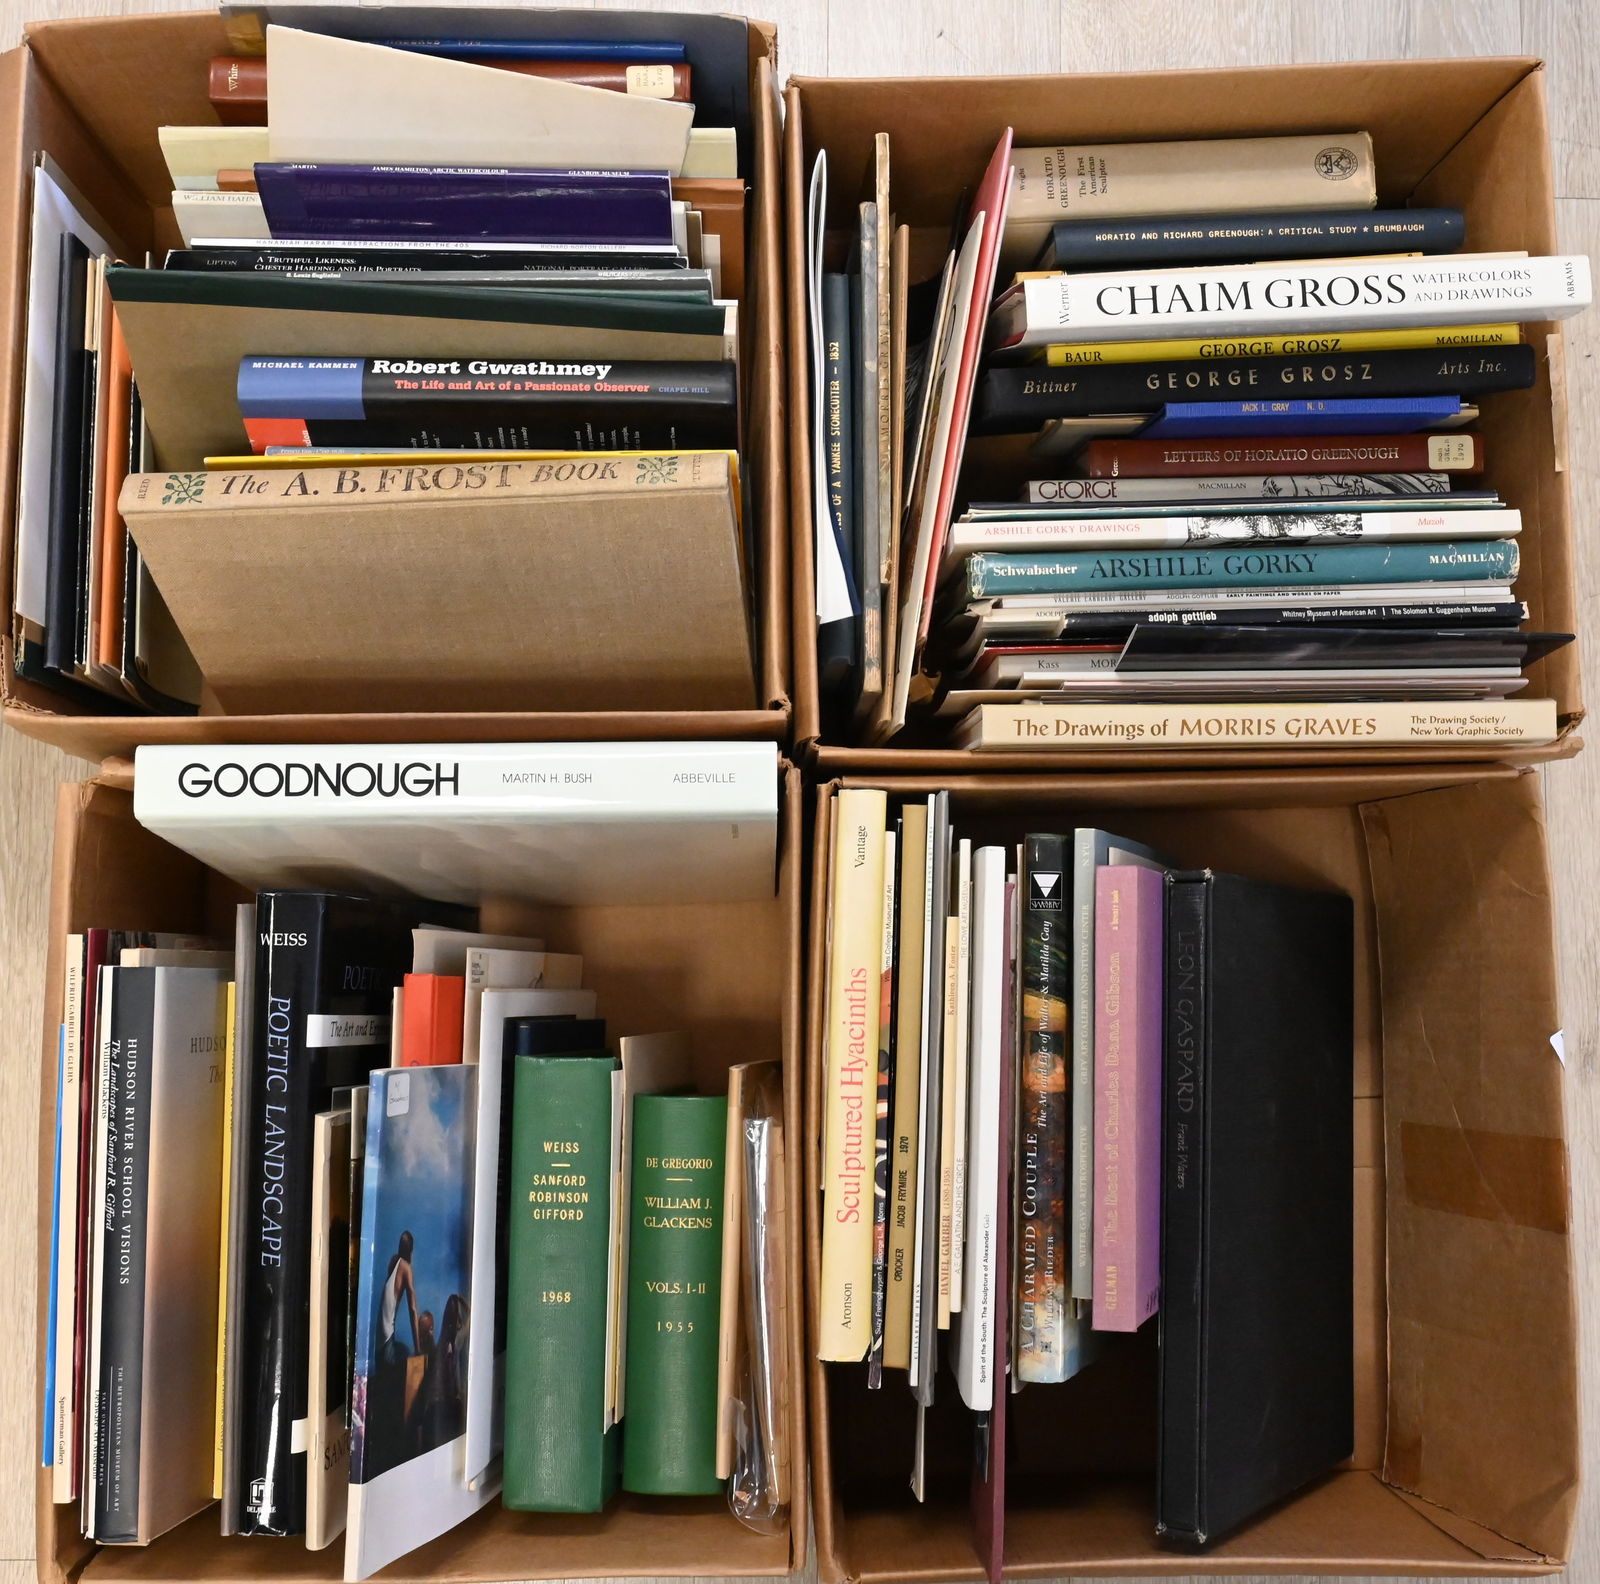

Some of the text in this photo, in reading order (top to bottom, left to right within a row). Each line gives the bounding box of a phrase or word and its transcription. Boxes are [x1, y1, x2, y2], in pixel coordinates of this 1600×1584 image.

[228, 62, 239, 92] White
[1018, 167, 1026, 192] Wright
[1046, 156, 1055, 201] HORATIO
[1057, 147, 1069, 209] GREENOUGH
[1077, 156, 1087, 198] The First
[1088, 156, 1098, 197] American
[1099, 157, 1109, 194] Sculptor
[1095, 223, 1425, 241] HORATIO AND RICHARD GREENOUGH: A CRITICAL STUDY BRUMBAUGH
[267, 256, 313, 264] TRUTHFUL
[1412, 269, 1532, 284] WATERCOLORS
[1566, 262, 1575, 298] ABRAMS
[1059, 282, 1070, 325] Werner
[1096, 273, 1407, 316] CHAIM GROSS
[1414, 286, 1533, 302] AND DRAWINGS
[829, 341, 840, 361] 1852
[1065, 333, 1503, 363] BAUR GEORGE GROSZ MACMILLAN
[252, 361, 304, 369] MICHAEL
[371, 359, 613, 380] Robert Gwathmey
[395, 379, 419, 390] The
[421, 379, 445, 390] Life
[447, 380, 472, 391] and
[474, 380, 495, 391] Art
[498, 380, 512, 391] of
[513, 383, 521, 391] a
[524, 381, 591, 392] Passionate
[594, 382, 650, 393] Observer
[1023, 359, 1507, 395] Bittner GEORGE GROSZ Arts Inc.
[829, 380, 841, 436] STONECUTTER
[831, 442, 841, 475] YANKEE
[1163, 447, 1400, 463] LETTERS OF HORATIO GREENOUGH
[137, 461, 622, 499] REED The A. B. FROST BOOK
[1038, 480, 1247, 500] GEORGE MACMILLAN
[832, 494, 842, 506] OF
[984, 523, 1141, 536] ARSHILE GORKY DRAWINGS
[992, 551, 1505, 579] Schwabacher ARSHILE GORKY MACMILLAN
[1148, 610, 1217, 624] adolph gottlieb
[1037, 659, 1060, 669] Kass
[1013, 717, 1377, 740] The Drawings of MORRIS GRAVES
[1410, 715, 1500, 726] The Drawing Society
[1410, 725, 1525, 737] New York Graphic Society
[177, 761, 737, 798] GOODNOUGH MARTIN H. BUSH ABBEVILLE
[854, 825, 867, 869] Vantage
[260, 932, 308, 947] WEISS
[1041, 920, 1052, 941] Gay
[1040, 944, 1050, 982] Matilda
[1039, 998, 1049, 1030] Walter
[1175, 931, 1195, 1113] LEON GASPARD
[1039, 1031, 1050, 1043] of
[1039, 1046, 1049, 1066] Life
[1039, 1067, 1048, 1087] and
[836, 967, 868, 1224] Sculptured Hyacinths
[1039, 1090, 1048, 1106] Art
[1038, 1109, 1047, 1129] The
[104, 1040, 121, 1231] The Landscapes of Sanford R. Gifford
[261, 995, 291, 1268] POETIC LANDSCAPE
[543, 1141, 580, 1154] WEISS
[1177, 1123, 1188, 1189] Frank Waters
[119, 1039, 138, 1285] HUDSON RIVER SCHOOL VISIONS
[645, 1157, 713, 1170] DE GREGORIO
[533, 1174, 587, 1187] SANFORD
[528, 1191, 589, 1204] ROBINSON
[644, 1196, 713, 1210] WILLIAM J.
[533, 1208, 584, 1221] GIFFORD
[894, 1136, 909, 1282] CROCKER JACOB FRYMIRE 1970
[643, 1216, 714, 1230] GLACKENS
[982, 1229, 990, 1263] Alexander
[1021, 1133, 1038, 1354] A CHARMED COUPLE
[541, 1290, 571, 1304] 1968
[645, 1281, 683, 1295] VOLS.
[981, 1271, 989, 1304] Sculpture
[1105, 1265, 1118, 1310] GELMAN
[841, 1283, 853, 1330] Aronson
[656, 1321, 695, 1334] 1955
[980, 1320, 988, 1342] South:
[980, 1343, 988, 1356] the
[979, 1364, 988, 1384] Spirit
